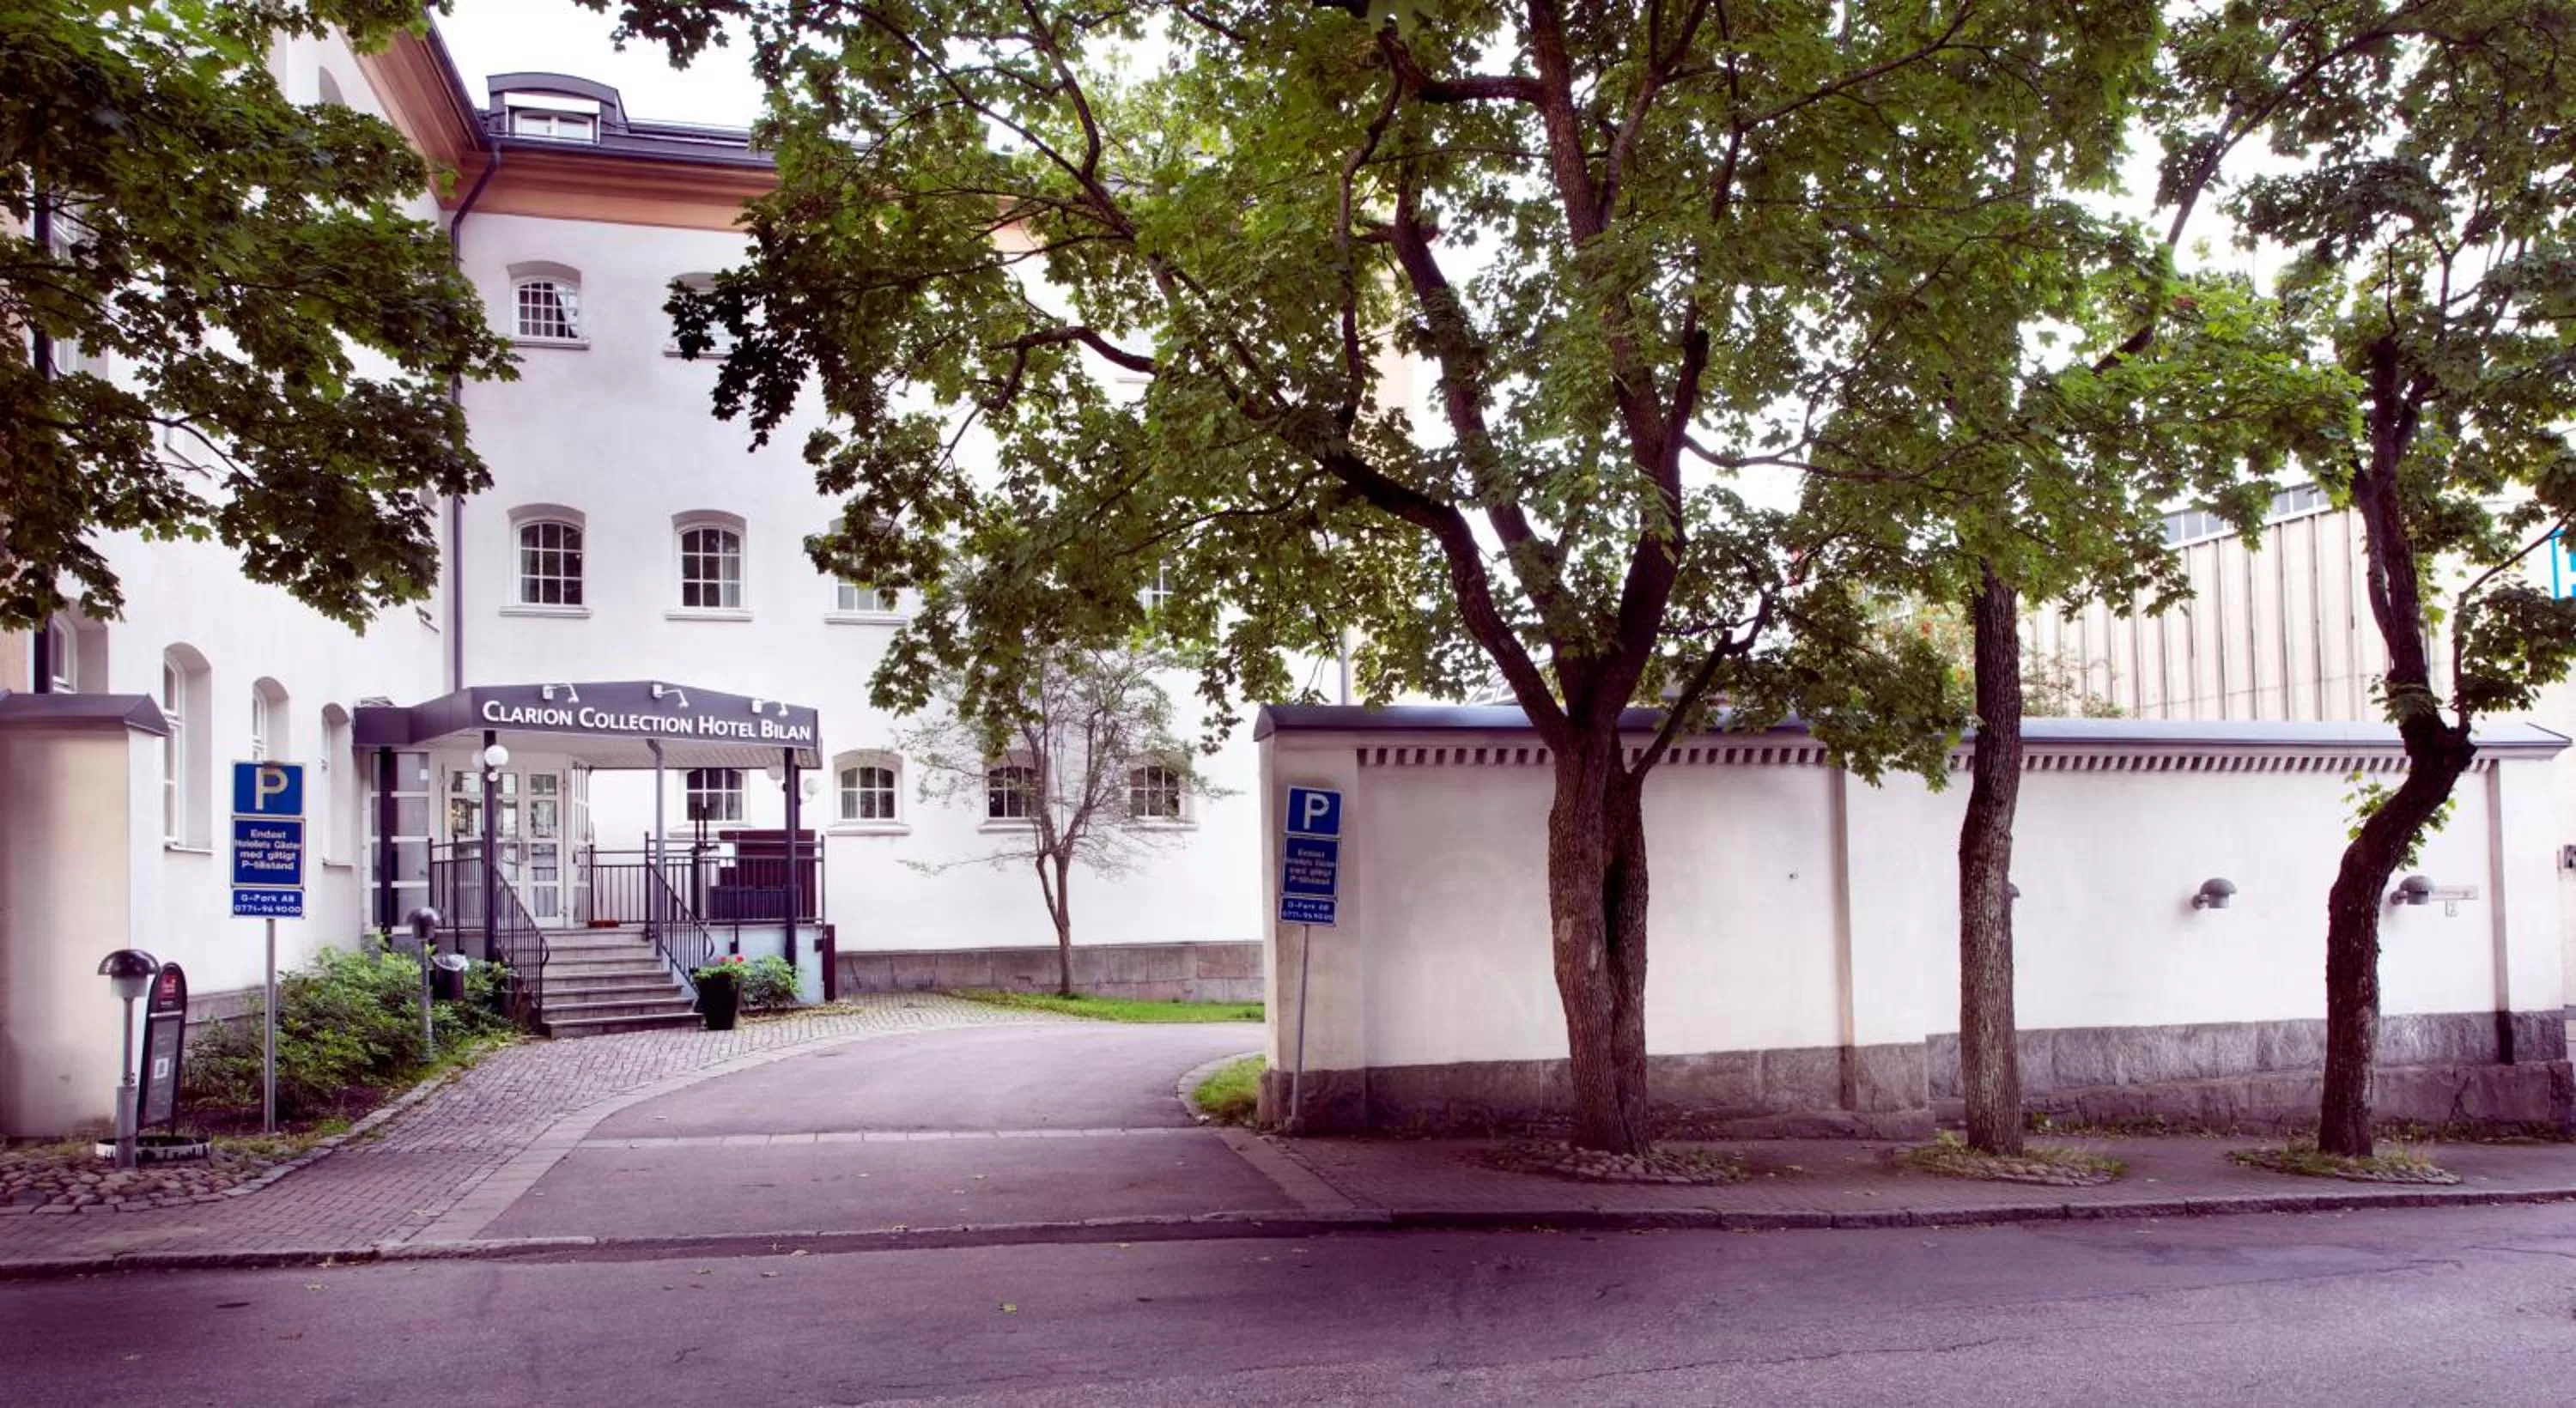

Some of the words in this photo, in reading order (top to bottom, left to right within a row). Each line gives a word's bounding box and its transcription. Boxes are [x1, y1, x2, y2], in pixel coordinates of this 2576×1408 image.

[483, 700, 573, 725] CLARION
[579, 707, 692, 734] COLLECTION
[698, 715, 756, 737] HOTEL
[761, 719, 811, 741] BILAN
[255, 768, 289, 810] P
[1303, 792, 1330, 829] P
[240, 850, 264, 859] med
